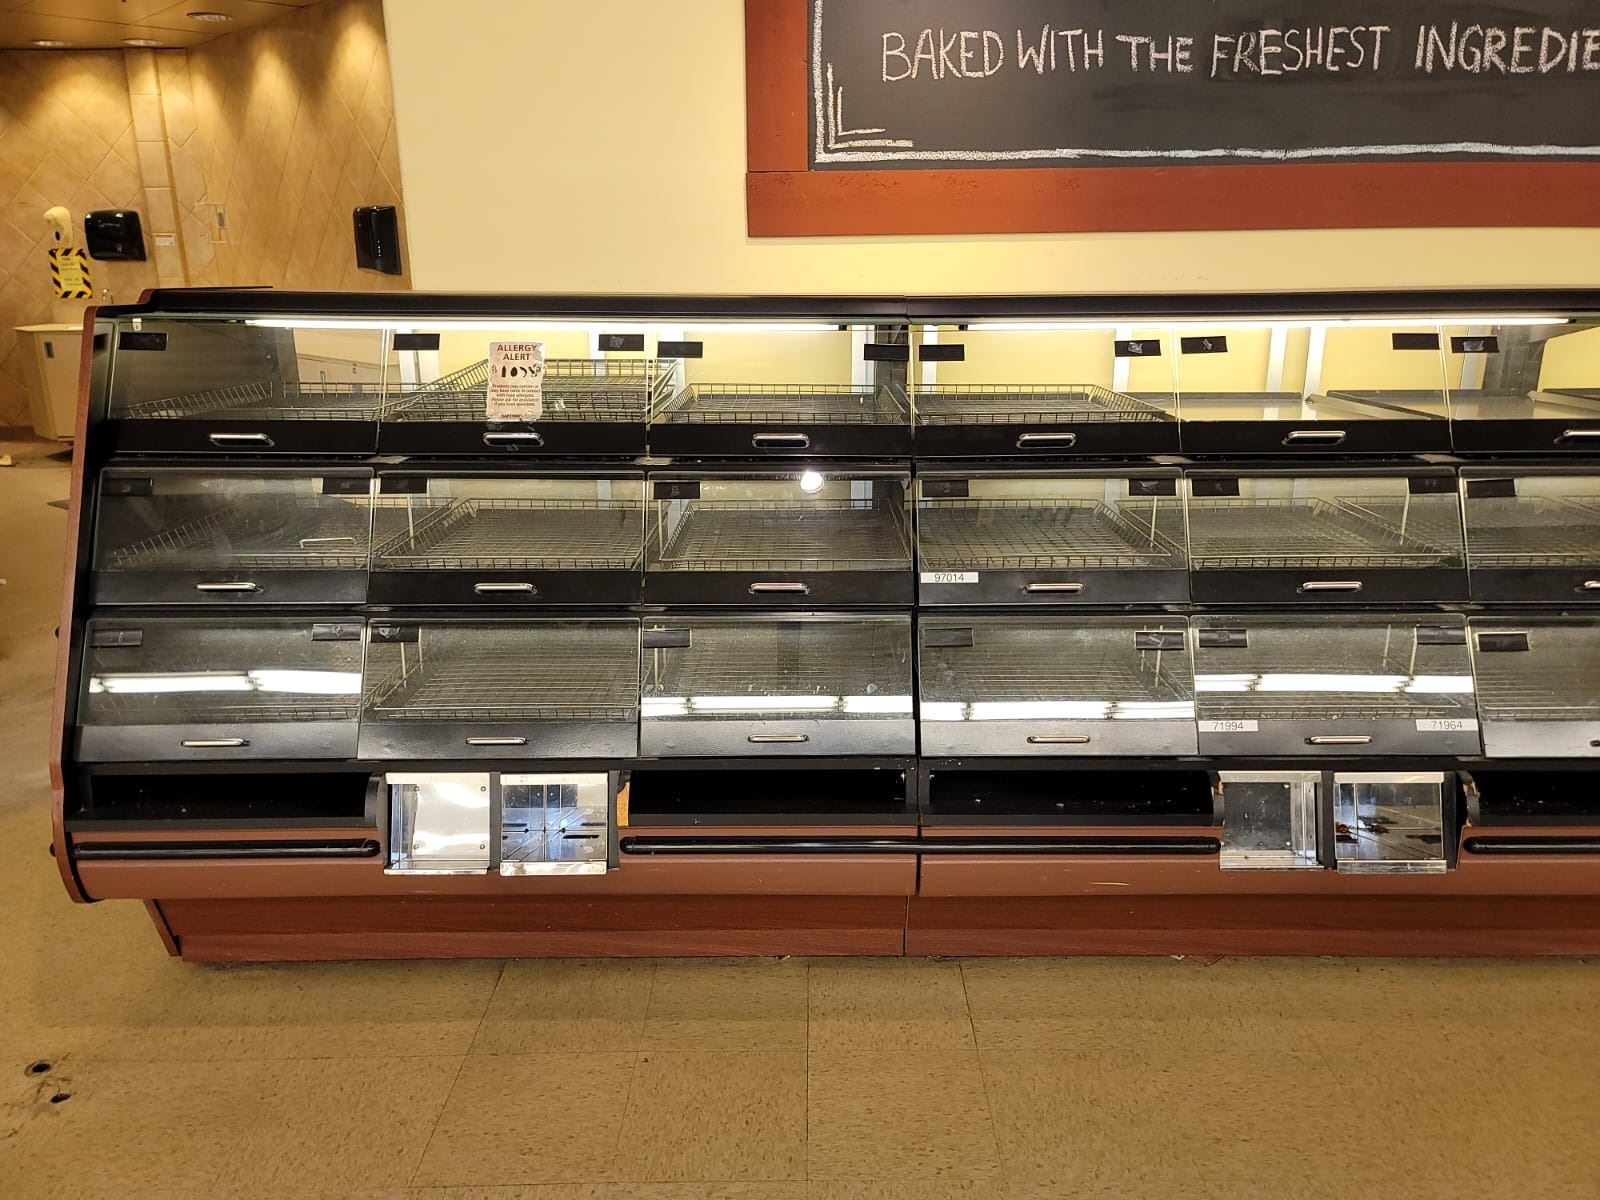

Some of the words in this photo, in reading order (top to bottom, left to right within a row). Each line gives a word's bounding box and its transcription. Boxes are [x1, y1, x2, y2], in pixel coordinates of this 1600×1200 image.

[882, 27, 1004, 82] BAKED
[1017, 24, 1104, 75] WITH
[1115, 34, 1194, 72] THE
[1211, 25, 1391, 78] FRESHEST
[1414, 20, 1600, 74] INGREDIE
[496, 344, 538, 352] ALLERGY
[502, 353, 531, 361] ALERT
[934, 573, 965, 582] 97014
[1212, 721, 1244, 731] 71994
[1431, 720, 1463, 730] 71964
